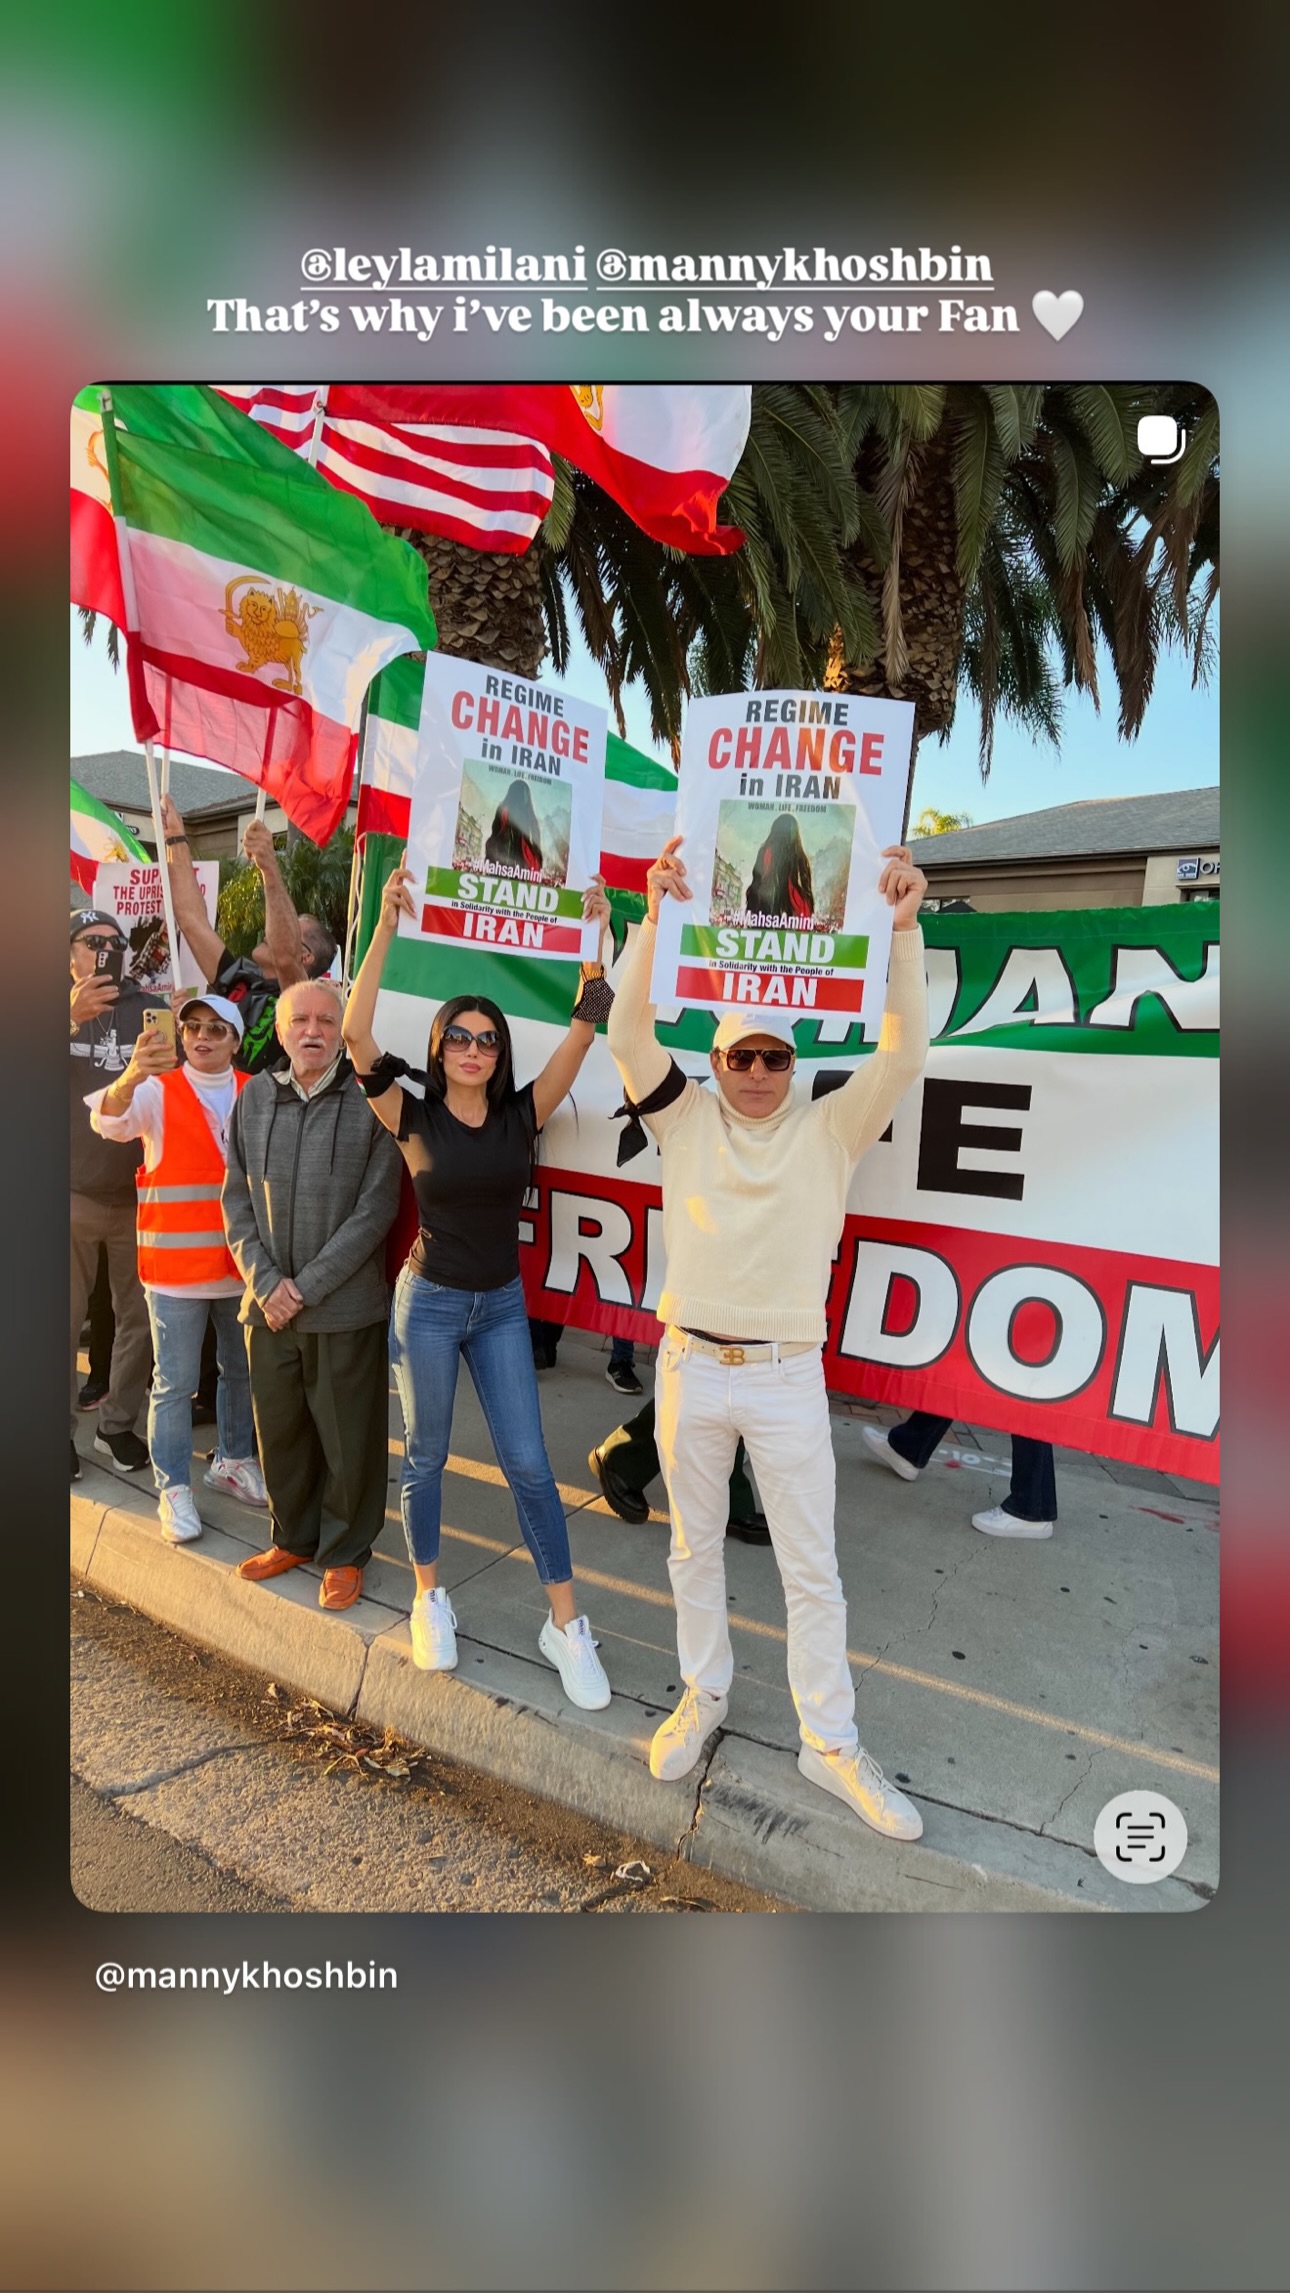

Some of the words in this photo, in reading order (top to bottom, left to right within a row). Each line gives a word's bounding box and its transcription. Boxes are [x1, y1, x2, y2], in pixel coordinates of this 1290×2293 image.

[486, 675, 564, 717] REGIME
[746, 699, 849, 725] REGIME
[452, 691, 589, 764] CHANGE
[481, 738, 502, 761] in
[512, 745, 561, 776] IRAN
[708, 726, 884, 776] CHANGE
[740, 773, 764, 796] in
[776, 774, 841, 800] IRAN
[472, 858, 543, 883] #MahsaAmini
[113, 886, 135, 900] THE
[457, 873, 559, 913] STAND
[452, 900, 459, 908] in
[460, 902, 494, 915] Solidarity
[496, 908, 512, 917] with
[513, 910, 524, 919] the
[526, 913, 549, 923] People
[733, 910, 814, 930] #MahsaAmini
[462, 913, 544, 948] IRAN
[716, 928, 835, 964] STAND
[709, 959, 717, 968] in
[719, 961, 758, 973] Solidarity
[760, 963, 778, 973] with
[780, 964, 793, 974] the
[795, 966, 823, 977] People
[825, 968, 834, 976] of
[722, 971, 818, 1007] IRAN
